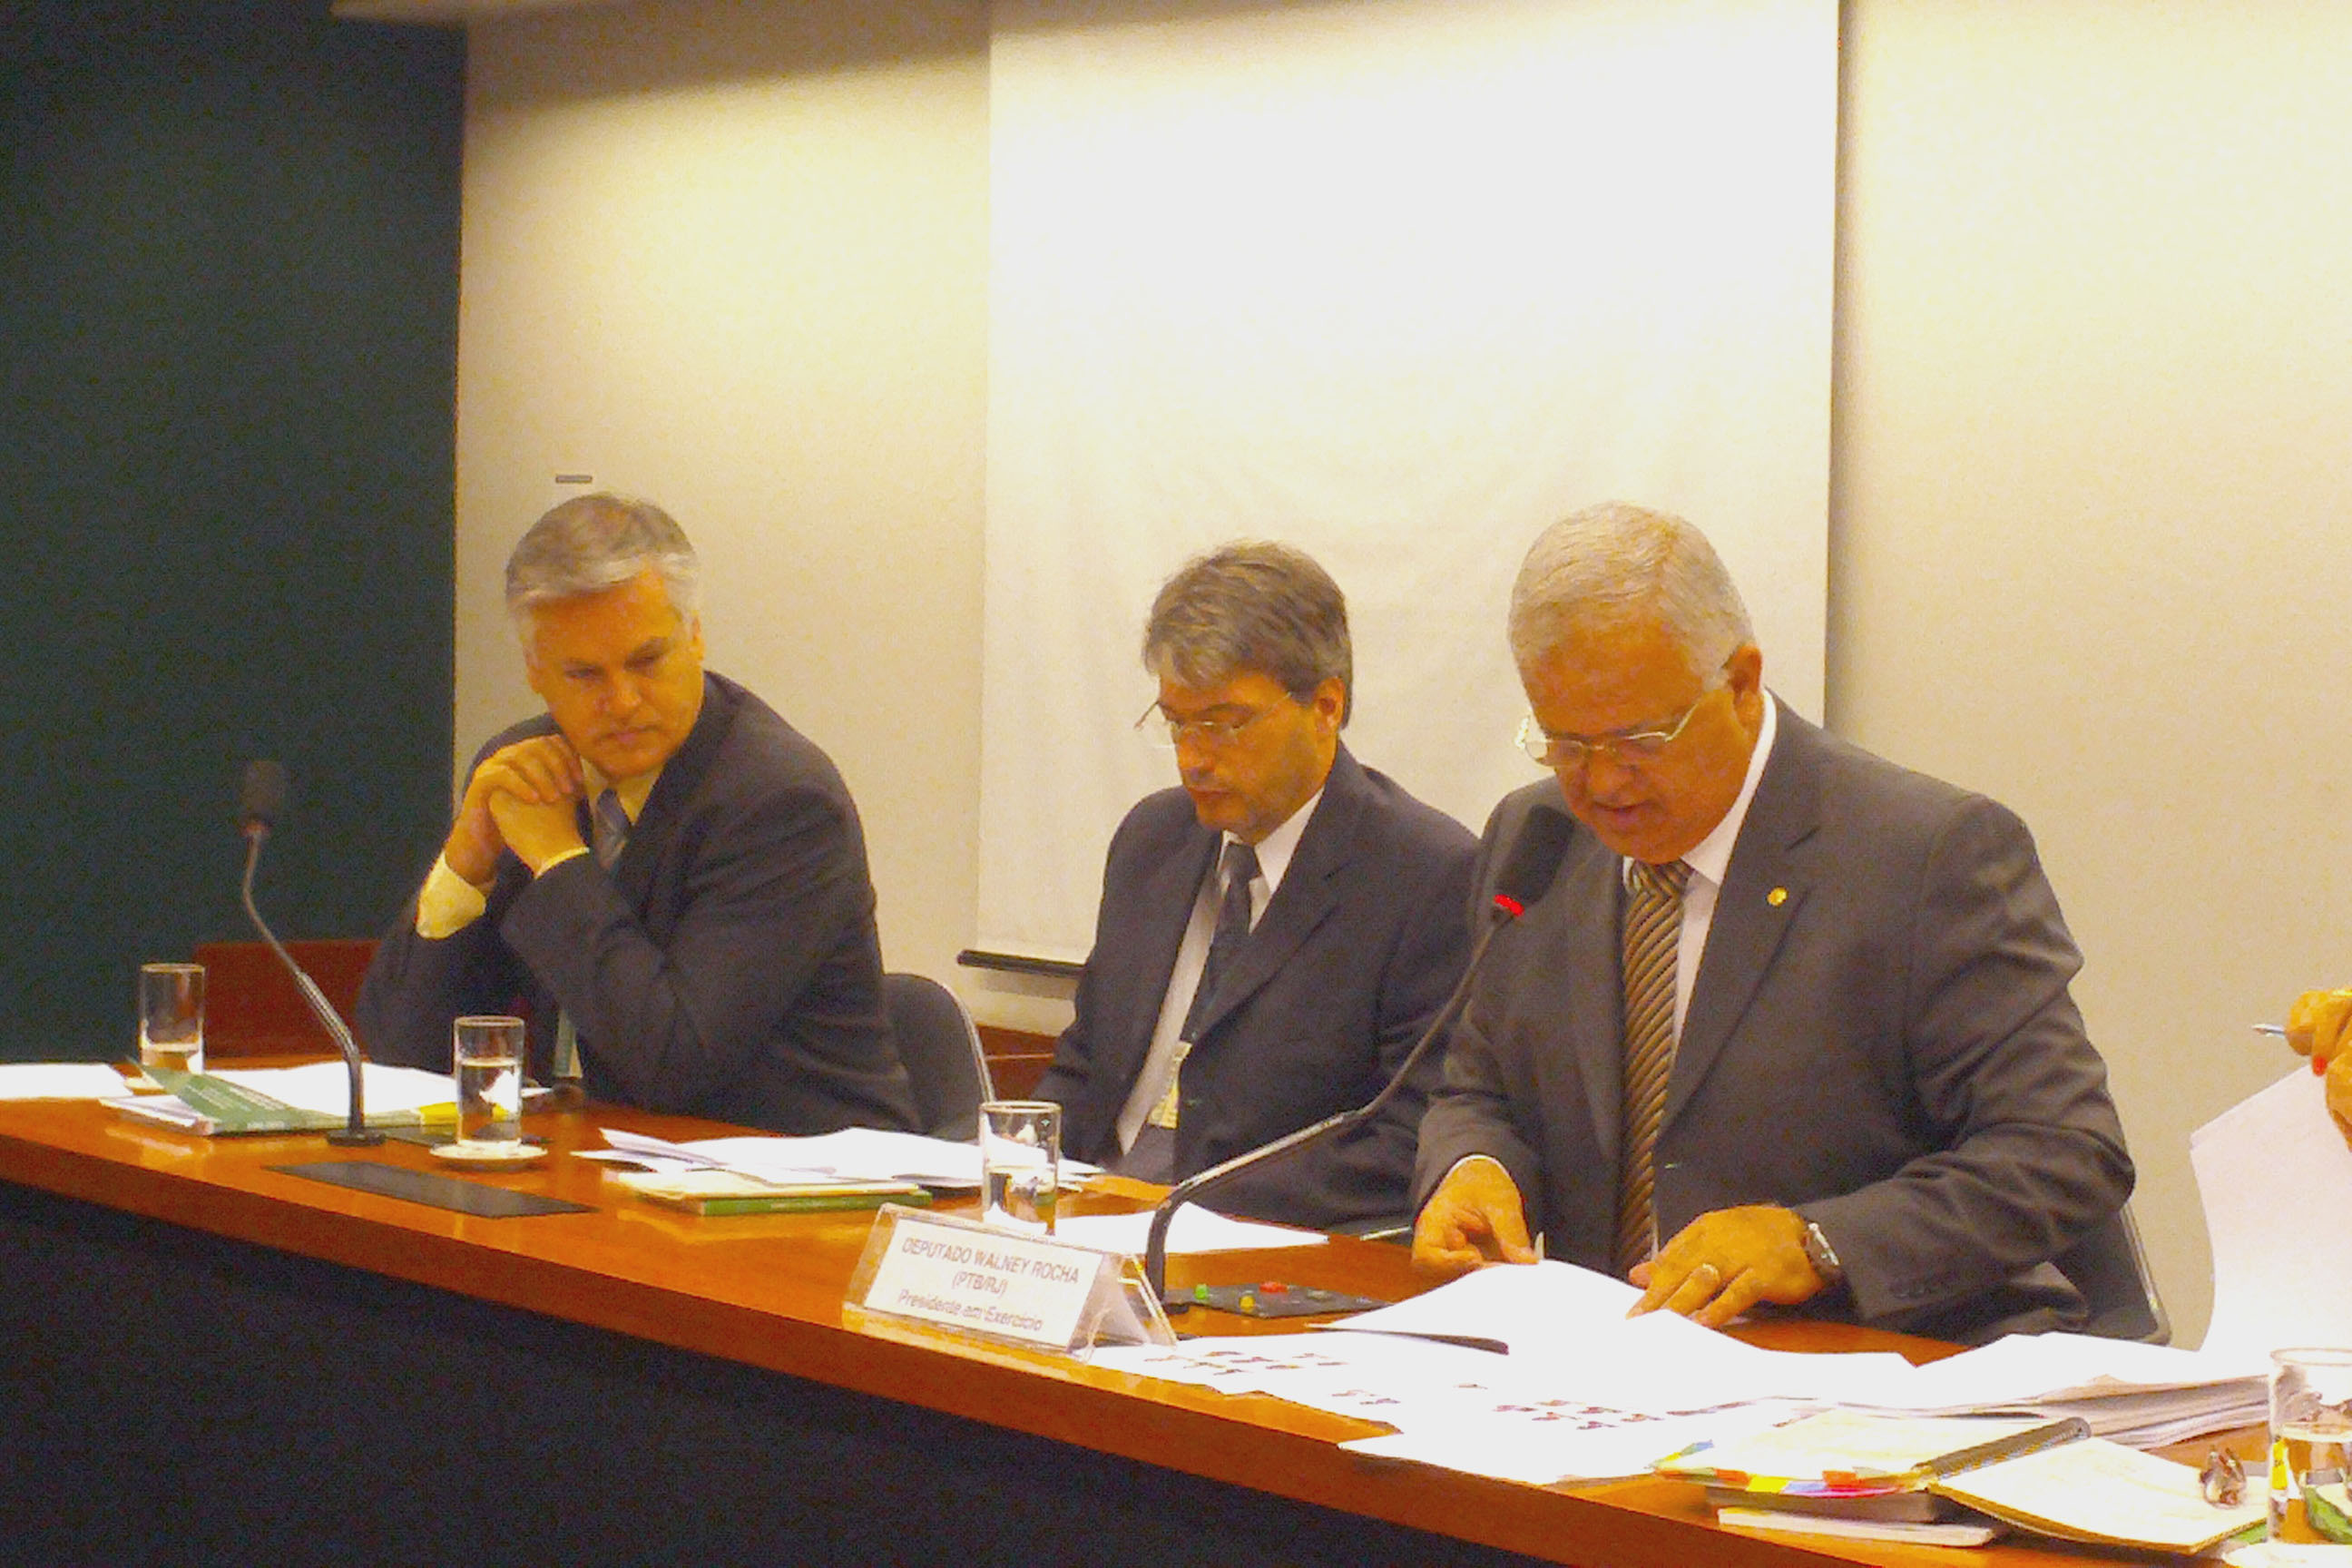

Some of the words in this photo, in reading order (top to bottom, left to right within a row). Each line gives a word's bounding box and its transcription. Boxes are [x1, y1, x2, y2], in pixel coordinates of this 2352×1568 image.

[901, 1238, 972, 1264] DEPUTADO
[974, 1251, 1031, 1274] WALNEY
[1032, 1260, 1079, 1284] ROCHA
[952, 1272, 1007, 1298] (PTB/RJ)
[897, 1289, 962, 1316] Presidente
[964, 1305, 984, 1318] em
